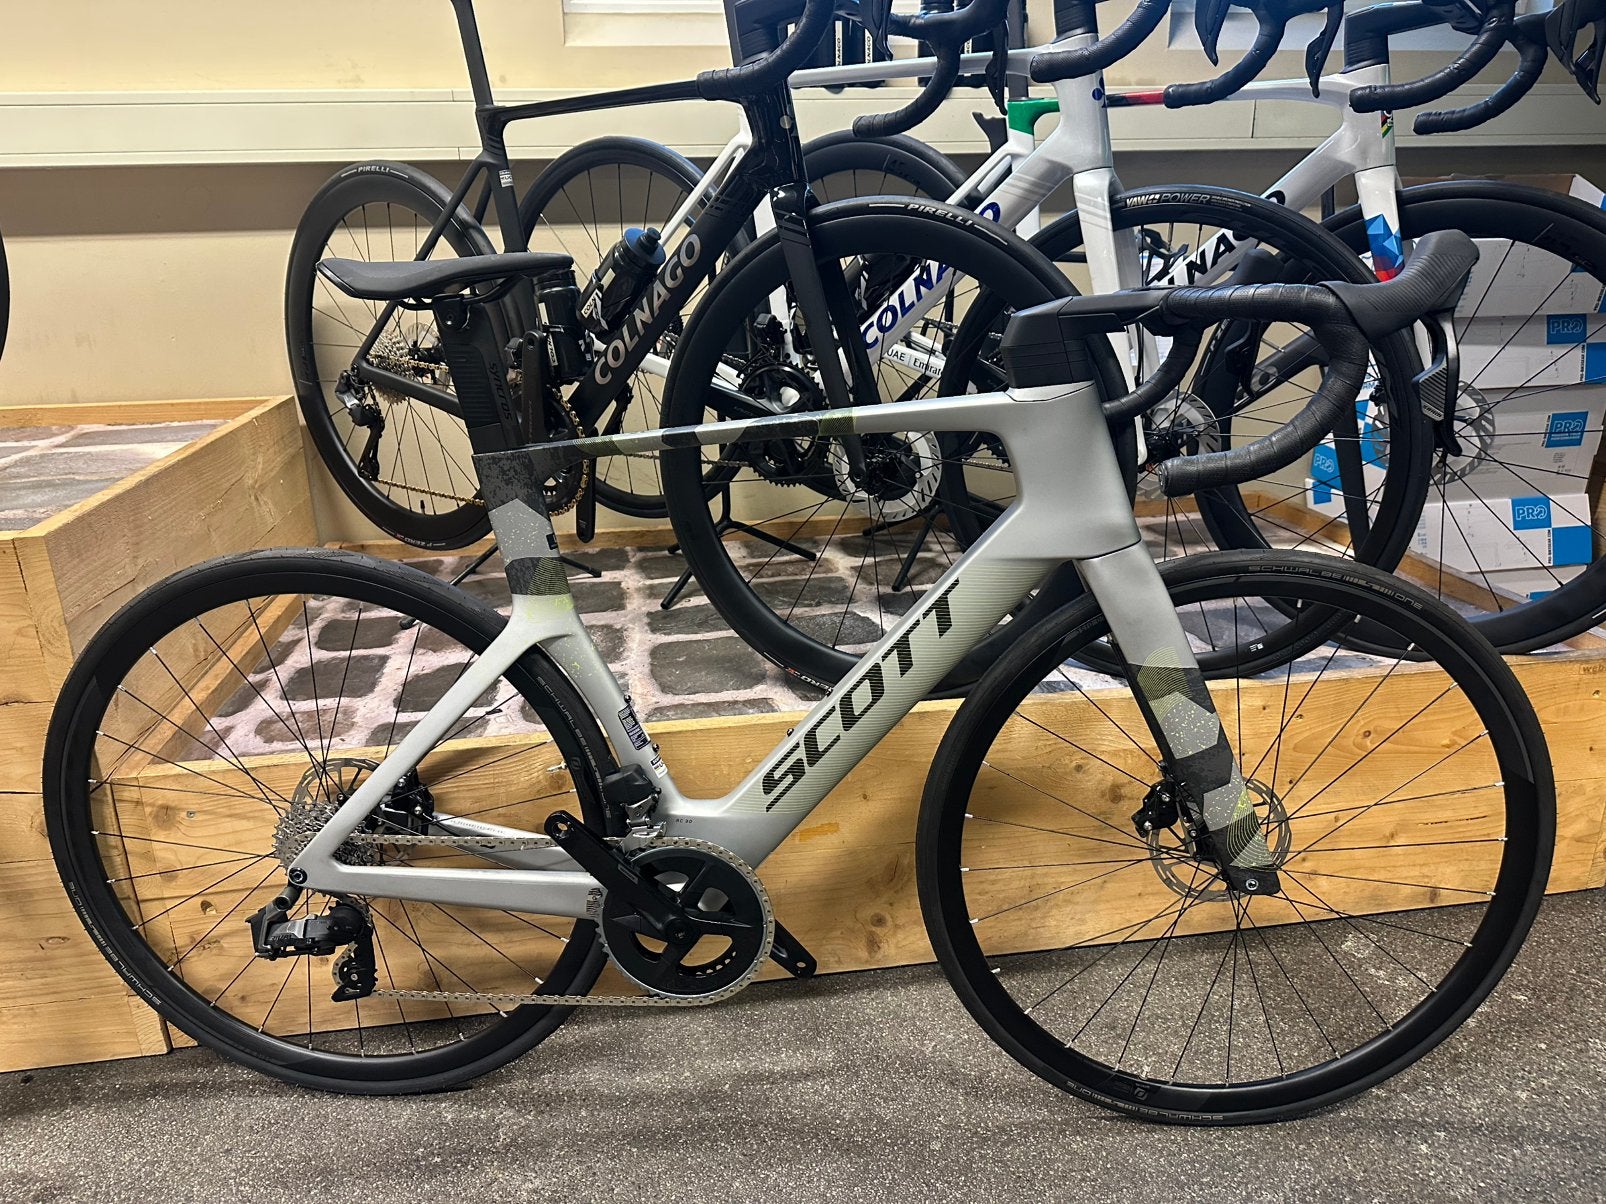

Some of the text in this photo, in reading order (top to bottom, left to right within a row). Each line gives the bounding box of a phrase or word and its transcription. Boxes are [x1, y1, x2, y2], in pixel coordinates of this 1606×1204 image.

[358, 165, 390, 173] PIRELLI
[1160, 193, 1210, 204] POWER
[907, 203, 973, 226] PIRELLI
[594, 234, 701, 385] COLNAGO
[1549, 318, 1584, 334] PRO
[887, 348, 941, 377] UAE Emirat
[1553, 419, 1584, 433] PRO
[1313, 453, 1335, 473] PRO
[1515, 505, 1549, 521] PRO
[1248, 565, 1342, 580] SCHWALBE
[762, 577, 960, 812] SCOTT
[536, 676, 587, 746] SCHWALBE
[105, 945, 161, 1005] SCHWALBE
[1139, 1107, 1223, 1121] SCHWALBE
